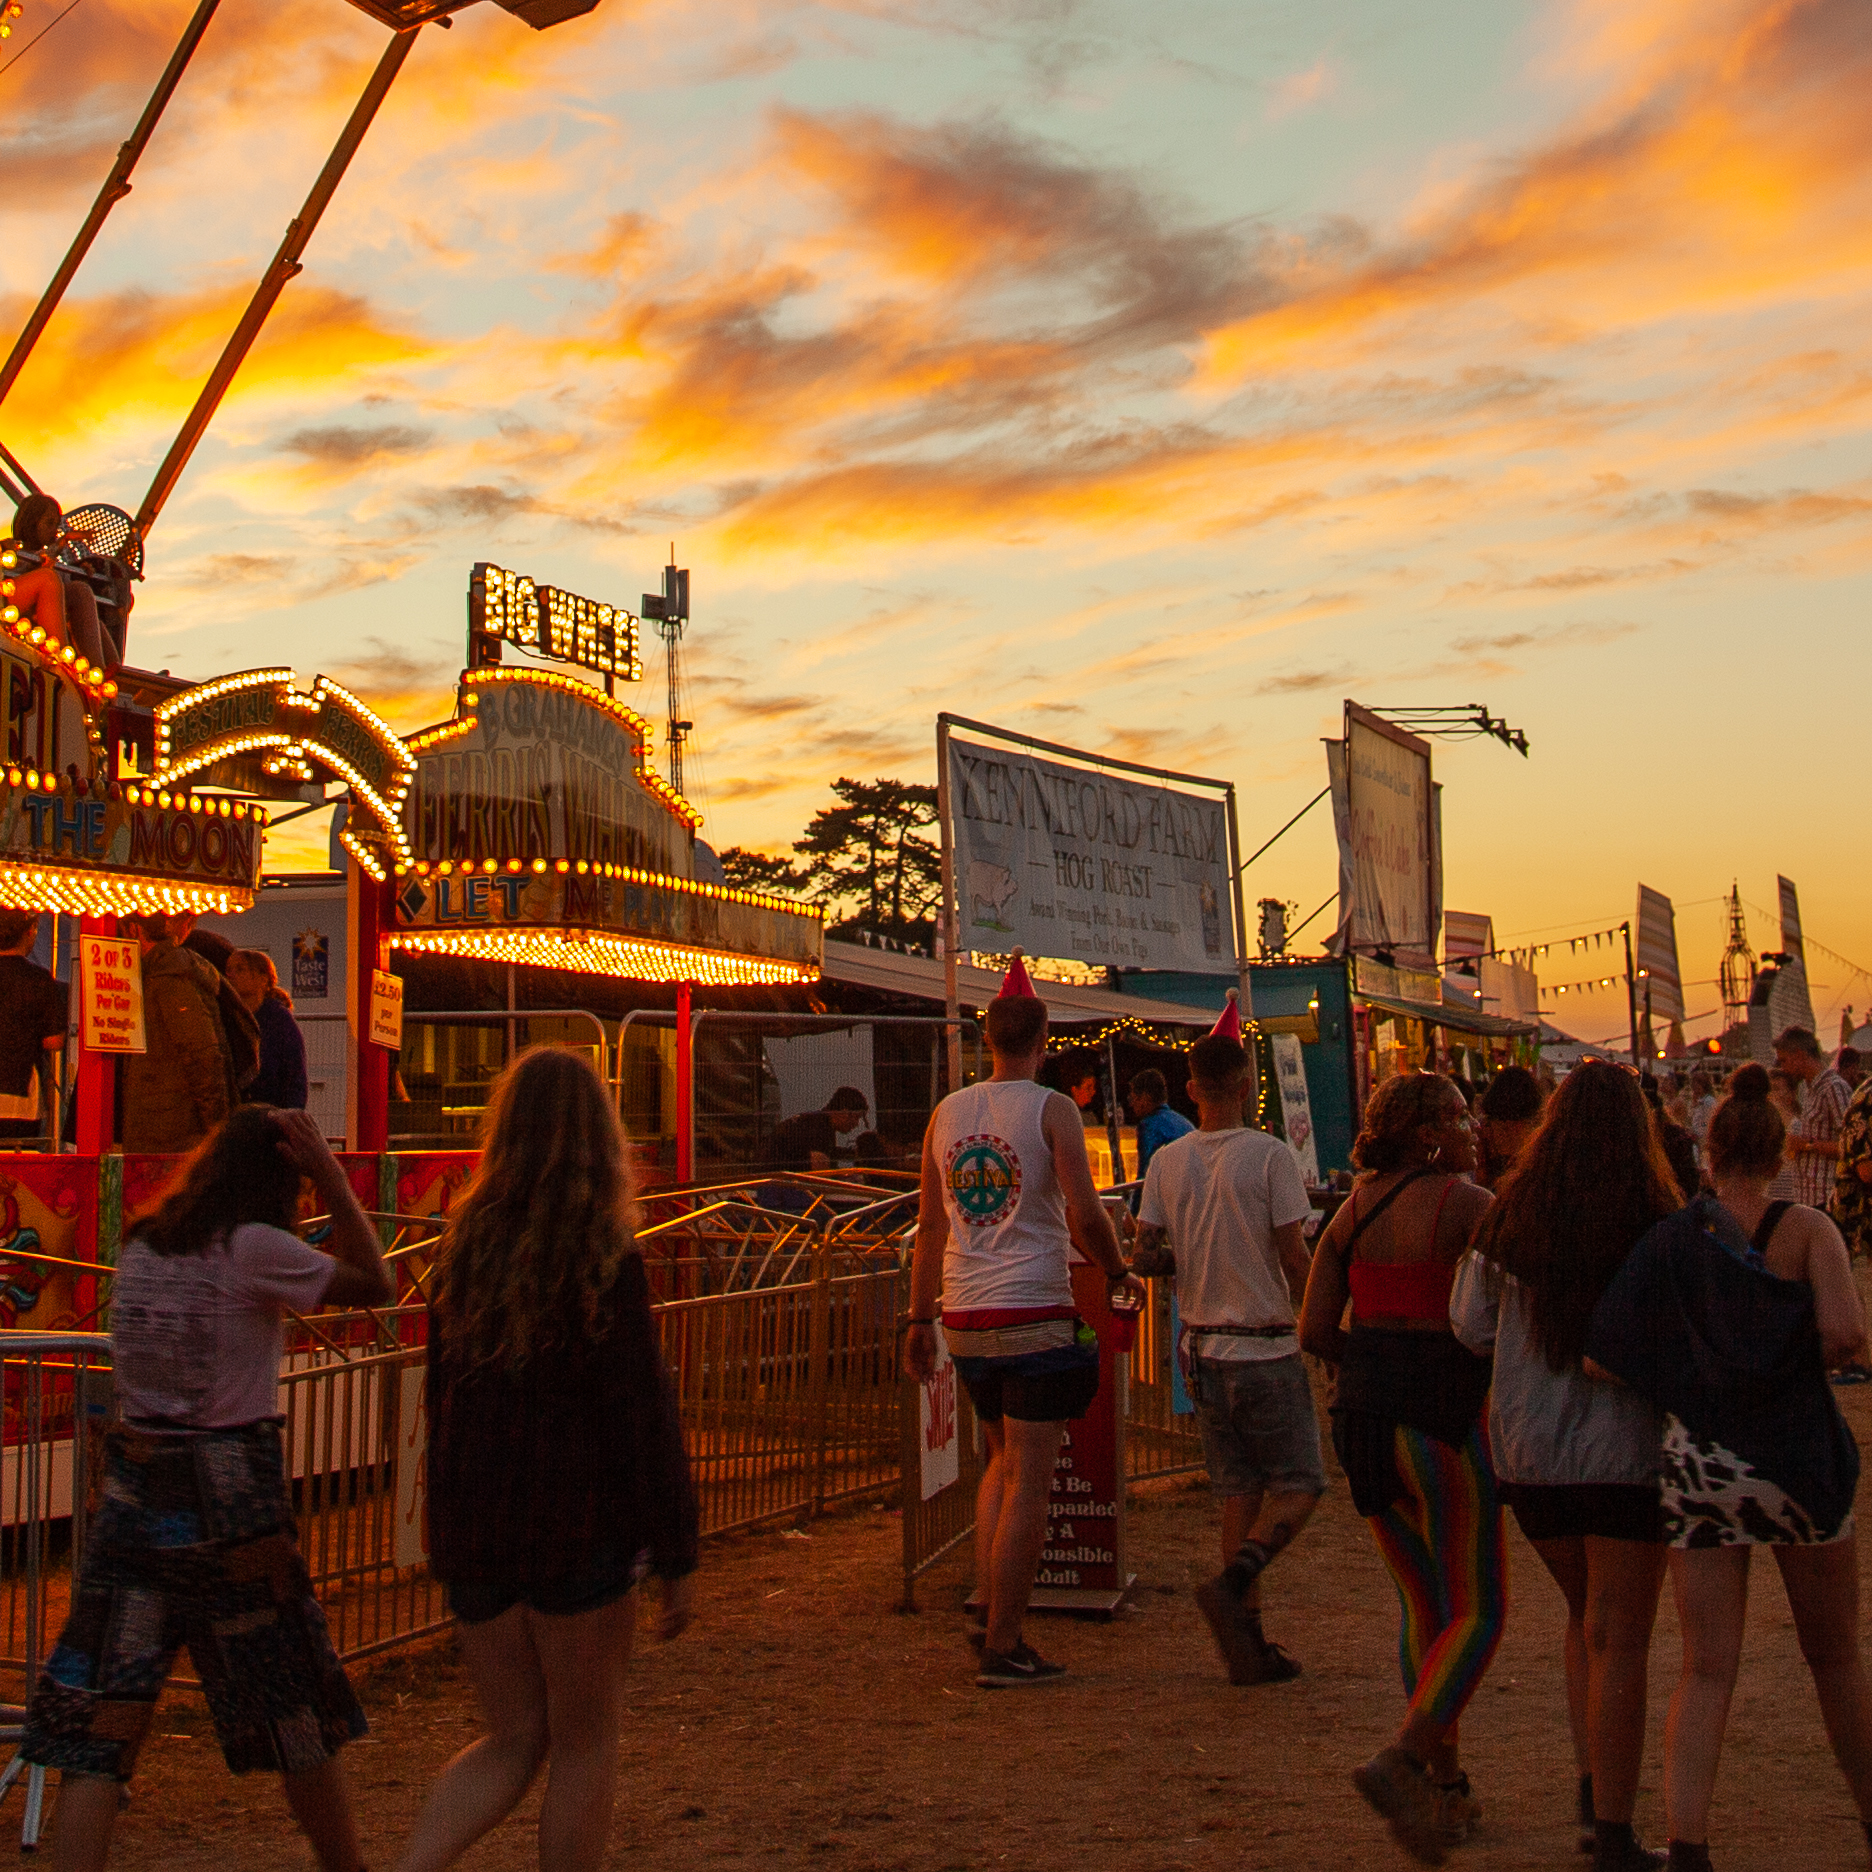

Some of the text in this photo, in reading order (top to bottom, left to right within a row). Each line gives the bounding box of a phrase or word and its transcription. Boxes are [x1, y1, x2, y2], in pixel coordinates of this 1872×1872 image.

[484, 565, 644, 683] BIG WHEEL
[169, 688, 275, 758] FESTIVAL
[320, 704, 386, 786] FERRIS
[414, 738, 688, 880] FERRIS WHEEL
[959, 754, 1221, 865] KENNIFORD FARM
[22, 790, 110, 860] THE
[127, 806, 256, 877] MOON
[1053, 849, 1152, 899] HOG ROAST
[436, 874, 530, 926] LET
[91, 942, 102, 968] 2
[122, 946, 133, 970] 3
[294, 958, 325, 971] Taste
[94, 971, 131, 993] Riders
[294, 973, 325, 986] West
[95, 993, 131, 1011] Per Car
[373, 980, 401, 1002] £2.50
[92, 1015, 136, 1032] No Single
[99, 1032, 131, 1046] Riders
[1065, 1477, 1092, 1493] Be
[1047, 1500, 1117, 1520] panied
[1060, 1522, 1076, 1539] A
[1042, 1546, 1113, 1563] onsible
